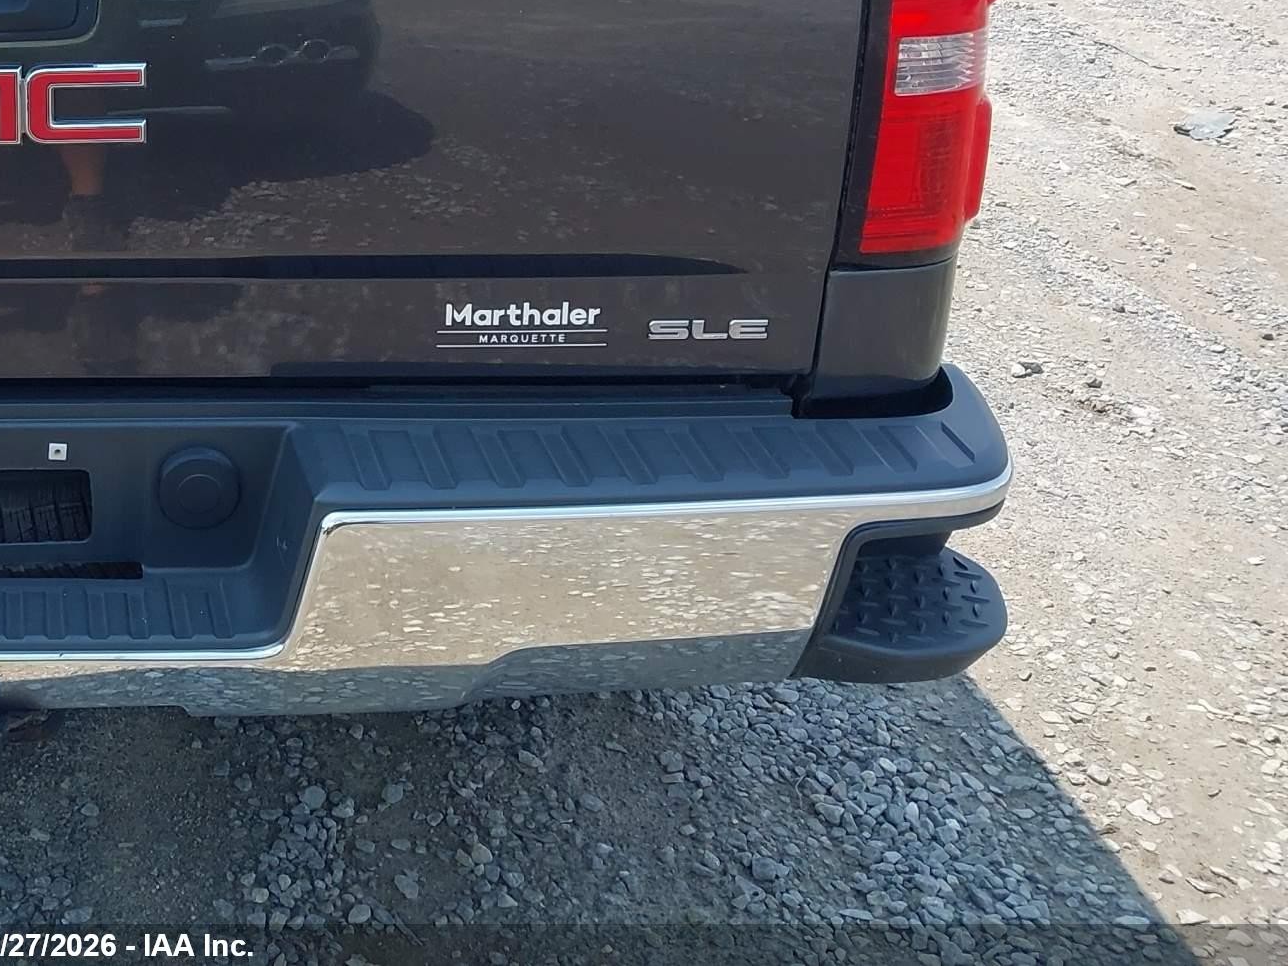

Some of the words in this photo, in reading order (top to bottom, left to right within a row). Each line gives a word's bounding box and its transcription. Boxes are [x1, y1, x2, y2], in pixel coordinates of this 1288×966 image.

[445, 302, 600, 326] Marthaler
[479, 334, 565, 343] MARQUETTE
[648, 319, 769, 340] SLE
